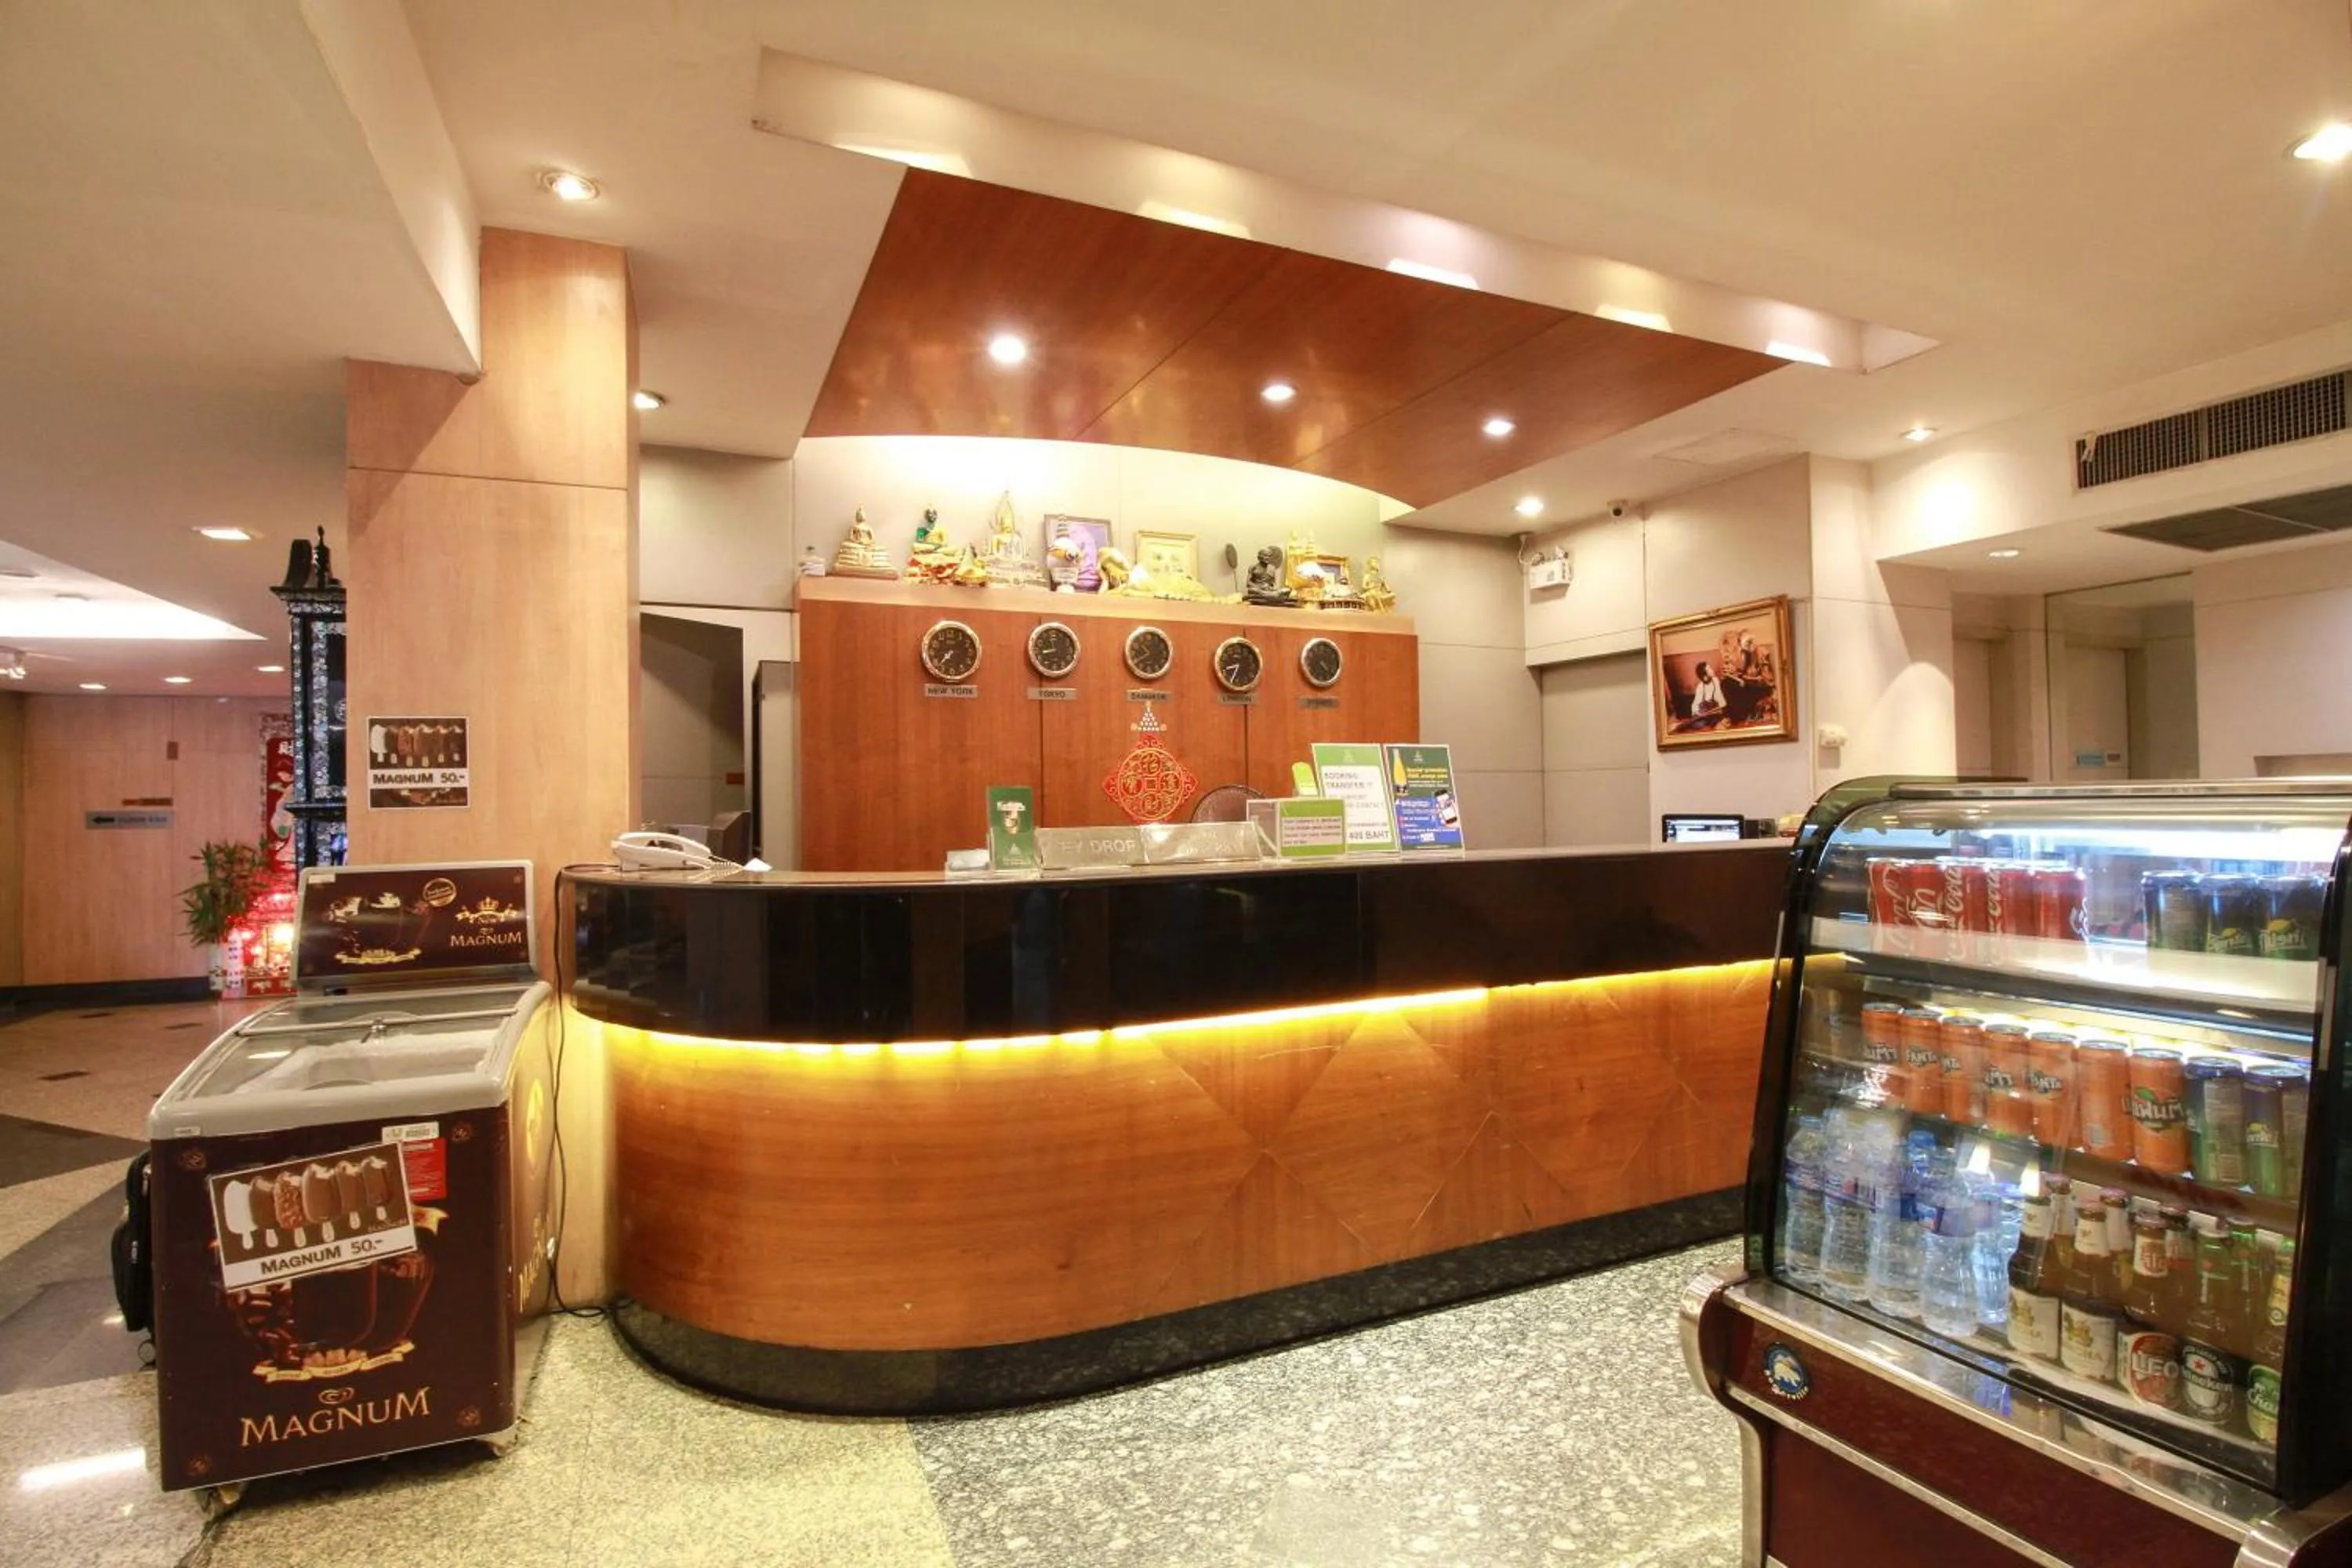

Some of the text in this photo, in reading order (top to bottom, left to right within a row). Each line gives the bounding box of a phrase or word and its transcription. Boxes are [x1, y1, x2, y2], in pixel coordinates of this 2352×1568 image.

[951, 688, 974, 696] YORK
[1038, 689, 1066, 698] TOKYO
[372, 772, 434, 785] MAGNUM
[450, 931, 522, 948] MAGNUM
[260, 1245, 342, 1276] MAGNUM
[2132, 1350, 2180, 1380] LEO
[238, 1385, 430, 1447] MAGNUM
